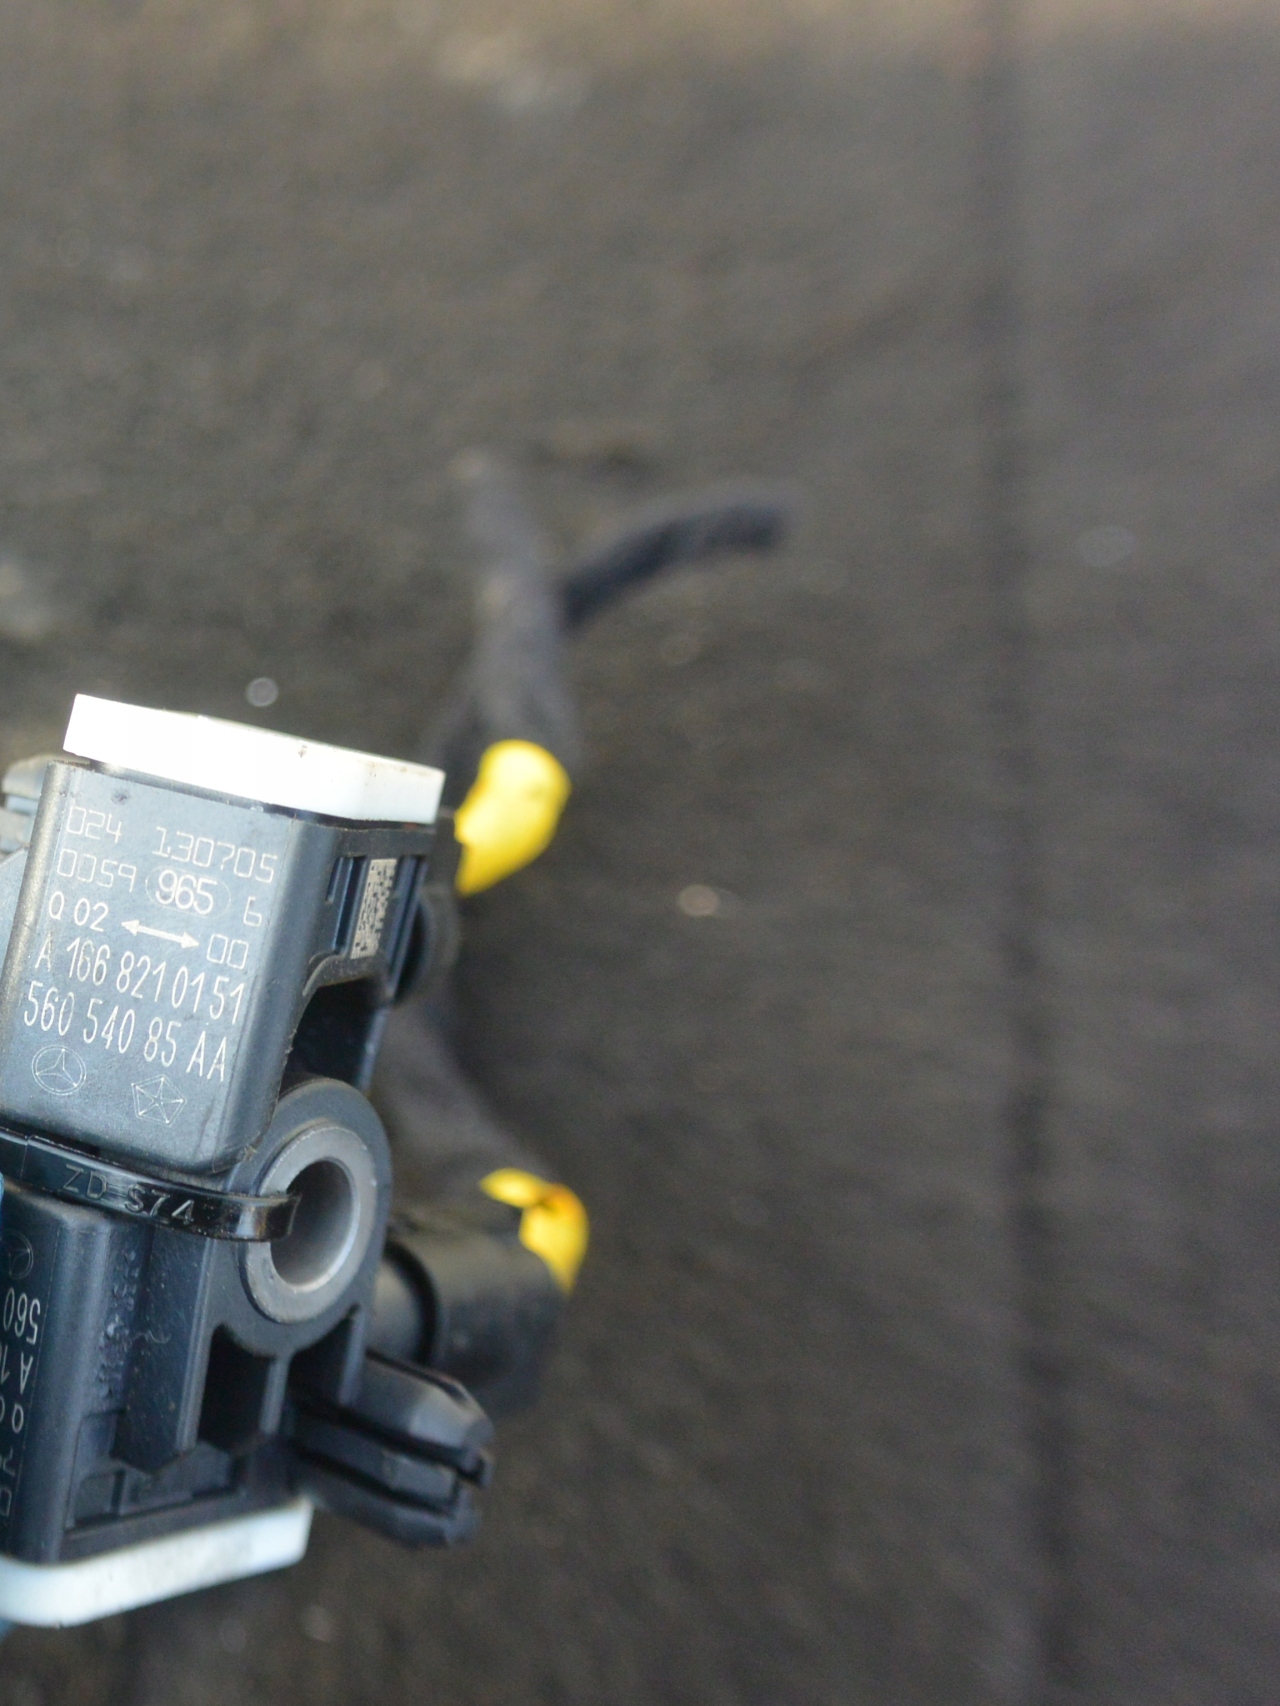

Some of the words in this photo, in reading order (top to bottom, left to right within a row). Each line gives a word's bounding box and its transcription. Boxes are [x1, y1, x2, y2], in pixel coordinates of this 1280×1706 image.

[66, 805, 122, 843] 024
[152, 826, 278, 883] 130705
[57, 848, 137, 893] 0059
[155, 869, 218, 915] 965
[243, 895, 263, 927] 6
[73, 897, 109, 932] 02
[34, 932, 53, 971] A
[66, 937, 111, 986] 166
[116, 951, 167, 1002] 821
[23, 980, 75, 1036] 560
[83, 998, 135, 1054] 540
[143, 1016, 182, 1067] 85
[185, 1030, 227, 1082] AA
[2, 1286, 41, 1346] 560
[19, 1351, 34, 1395] A
